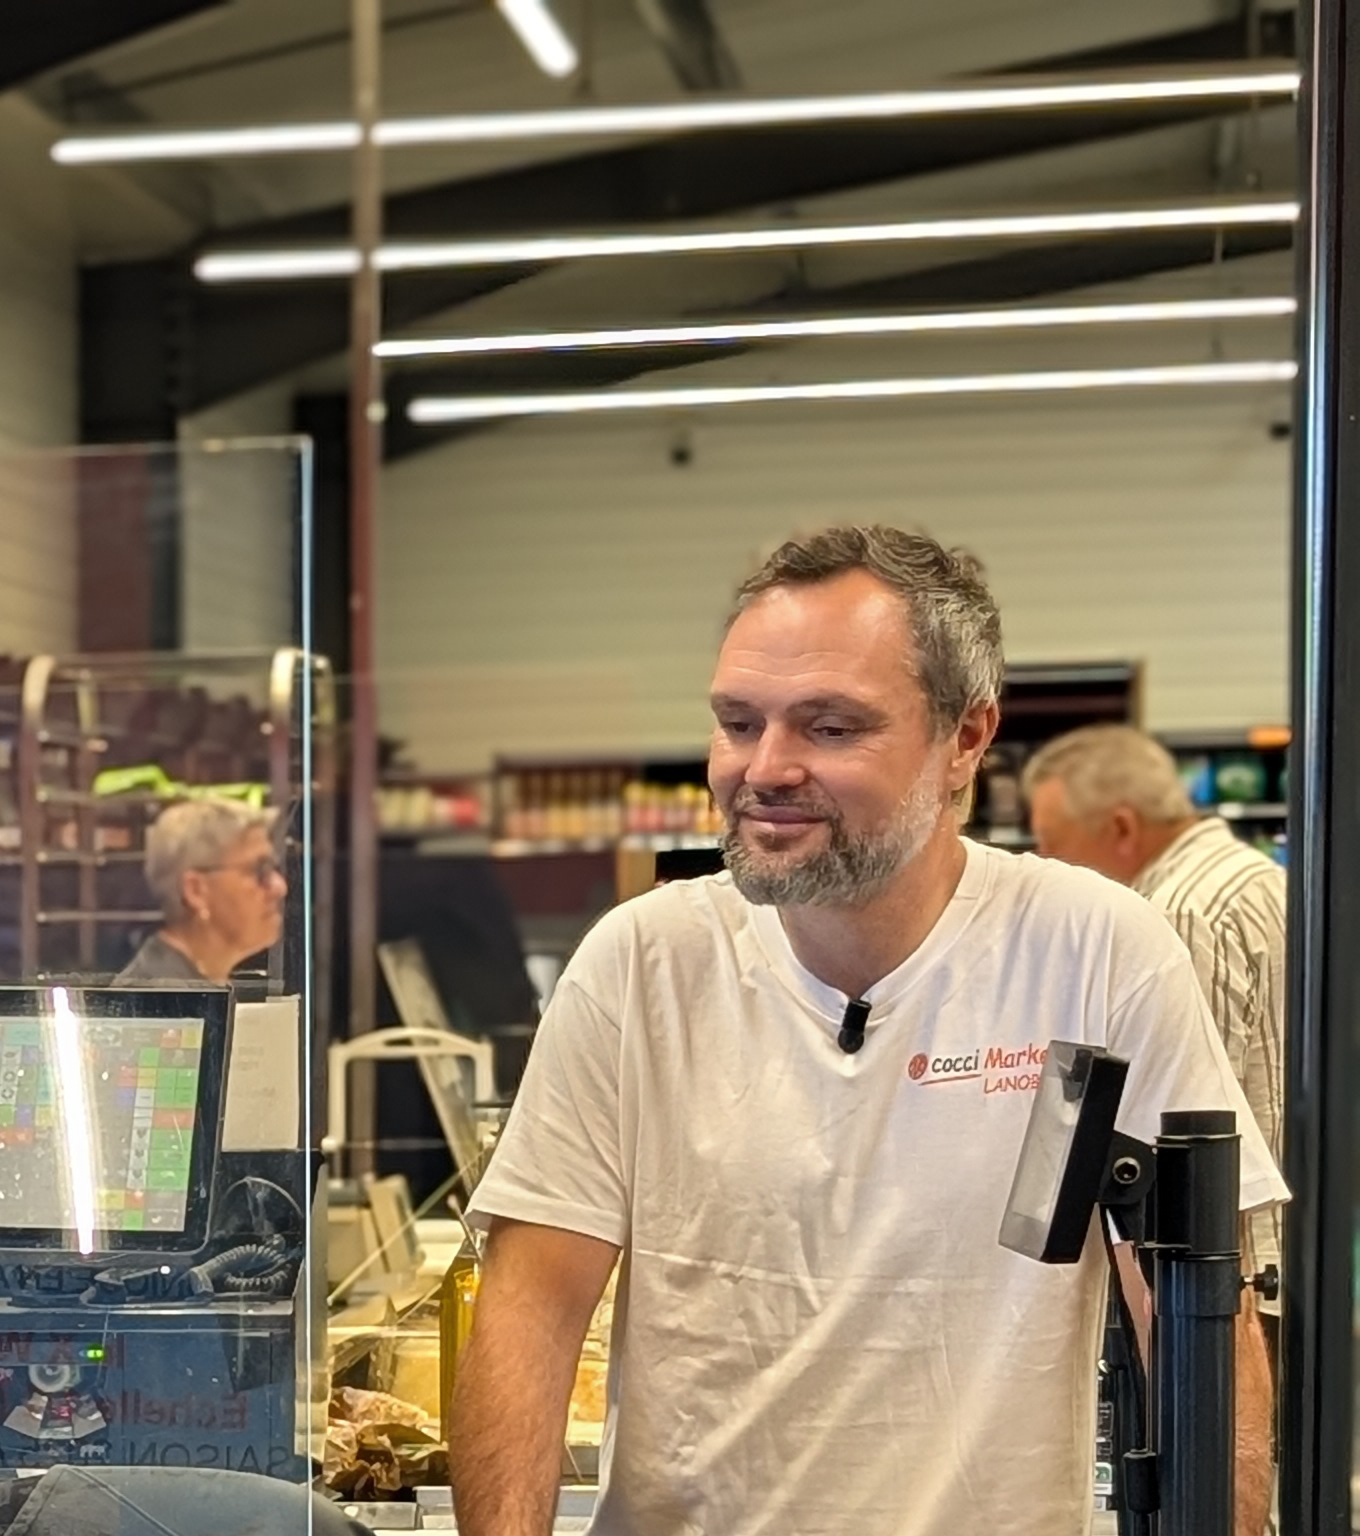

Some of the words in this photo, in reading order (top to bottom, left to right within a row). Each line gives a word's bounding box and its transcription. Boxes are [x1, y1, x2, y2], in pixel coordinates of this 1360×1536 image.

[931, 1049, 980, 1073] cocci
[984, 1042, 1049, 1069] Marke
[984, 1073, 1041, 1094] LANOB
